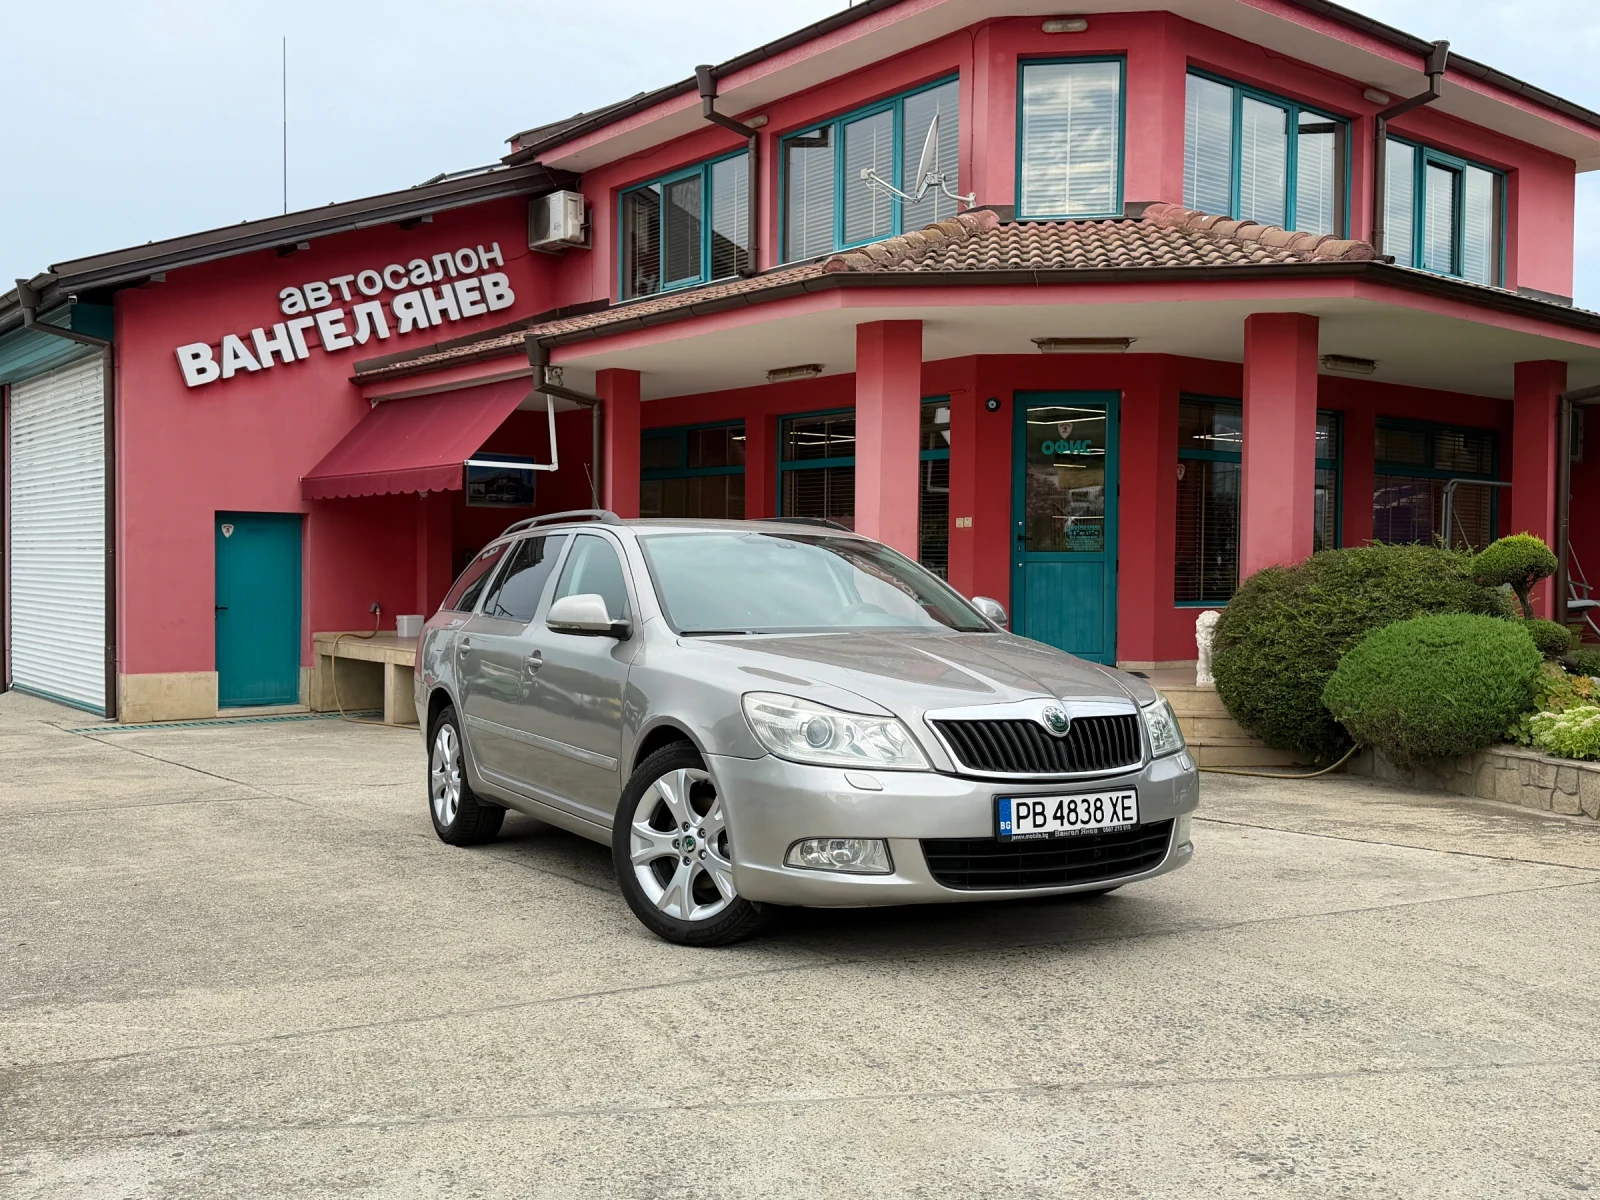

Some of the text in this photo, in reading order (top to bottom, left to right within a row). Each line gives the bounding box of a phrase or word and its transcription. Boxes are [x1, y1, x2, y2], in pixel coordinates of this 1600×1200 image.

[279, 242, 505, 315] автосалон
[176, 272, 515, 387] ВАНГЕЛ ЯНЕВ
[1000, 821, 1011, 830] BG
[1016, 795, 1134, 830] PB 4838 XE
